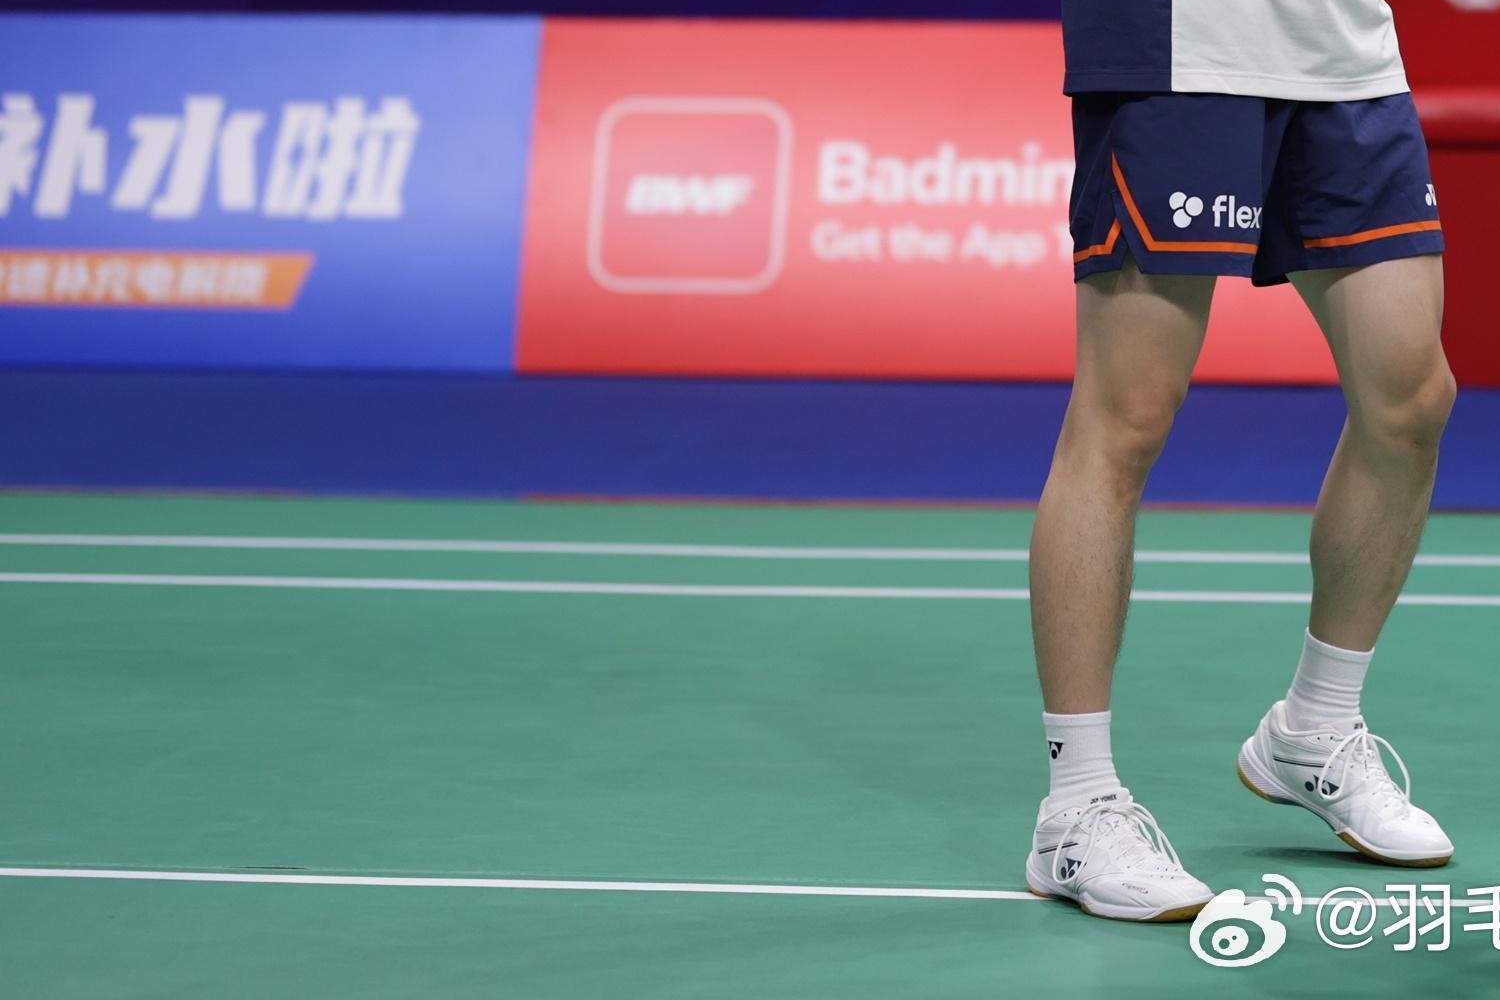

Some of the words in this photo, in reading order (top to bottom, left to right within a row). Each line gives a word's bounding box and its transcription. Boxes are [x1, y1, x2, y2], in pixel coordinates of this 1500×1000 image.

[0, 93, 420, 220] 补水啦
[1212, 195, 1262, 229] flex
[811, 219, 882, 262] Get
[960, 221, 1044, 269] App
